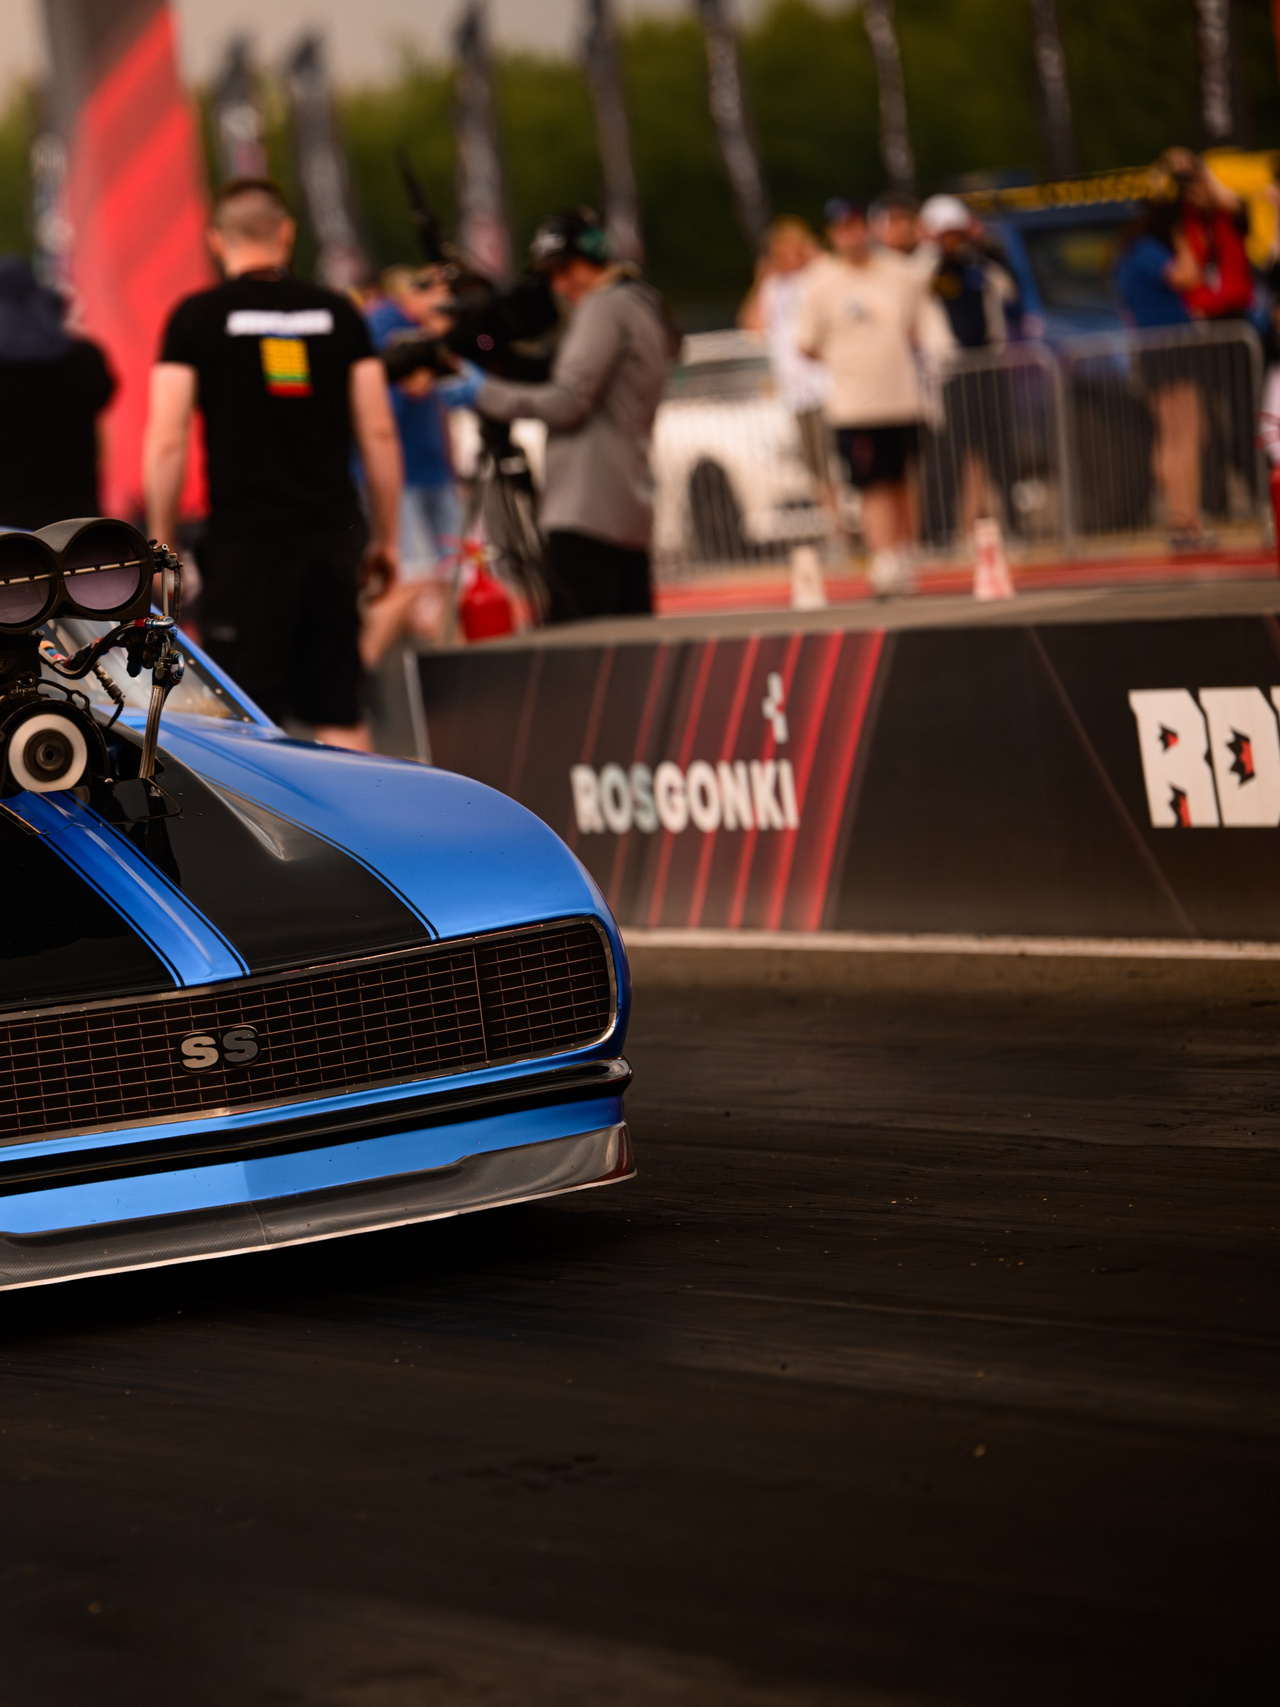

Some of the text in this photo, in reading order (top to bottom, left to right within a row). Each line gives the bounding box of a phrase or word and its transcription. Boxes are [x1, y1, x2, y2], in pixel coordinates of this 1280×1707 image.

[1128, 685, 1280, 828] RD
[571, 759, 800, 834] ROSGONKI
[180, 1028, 260, 1069] SS
